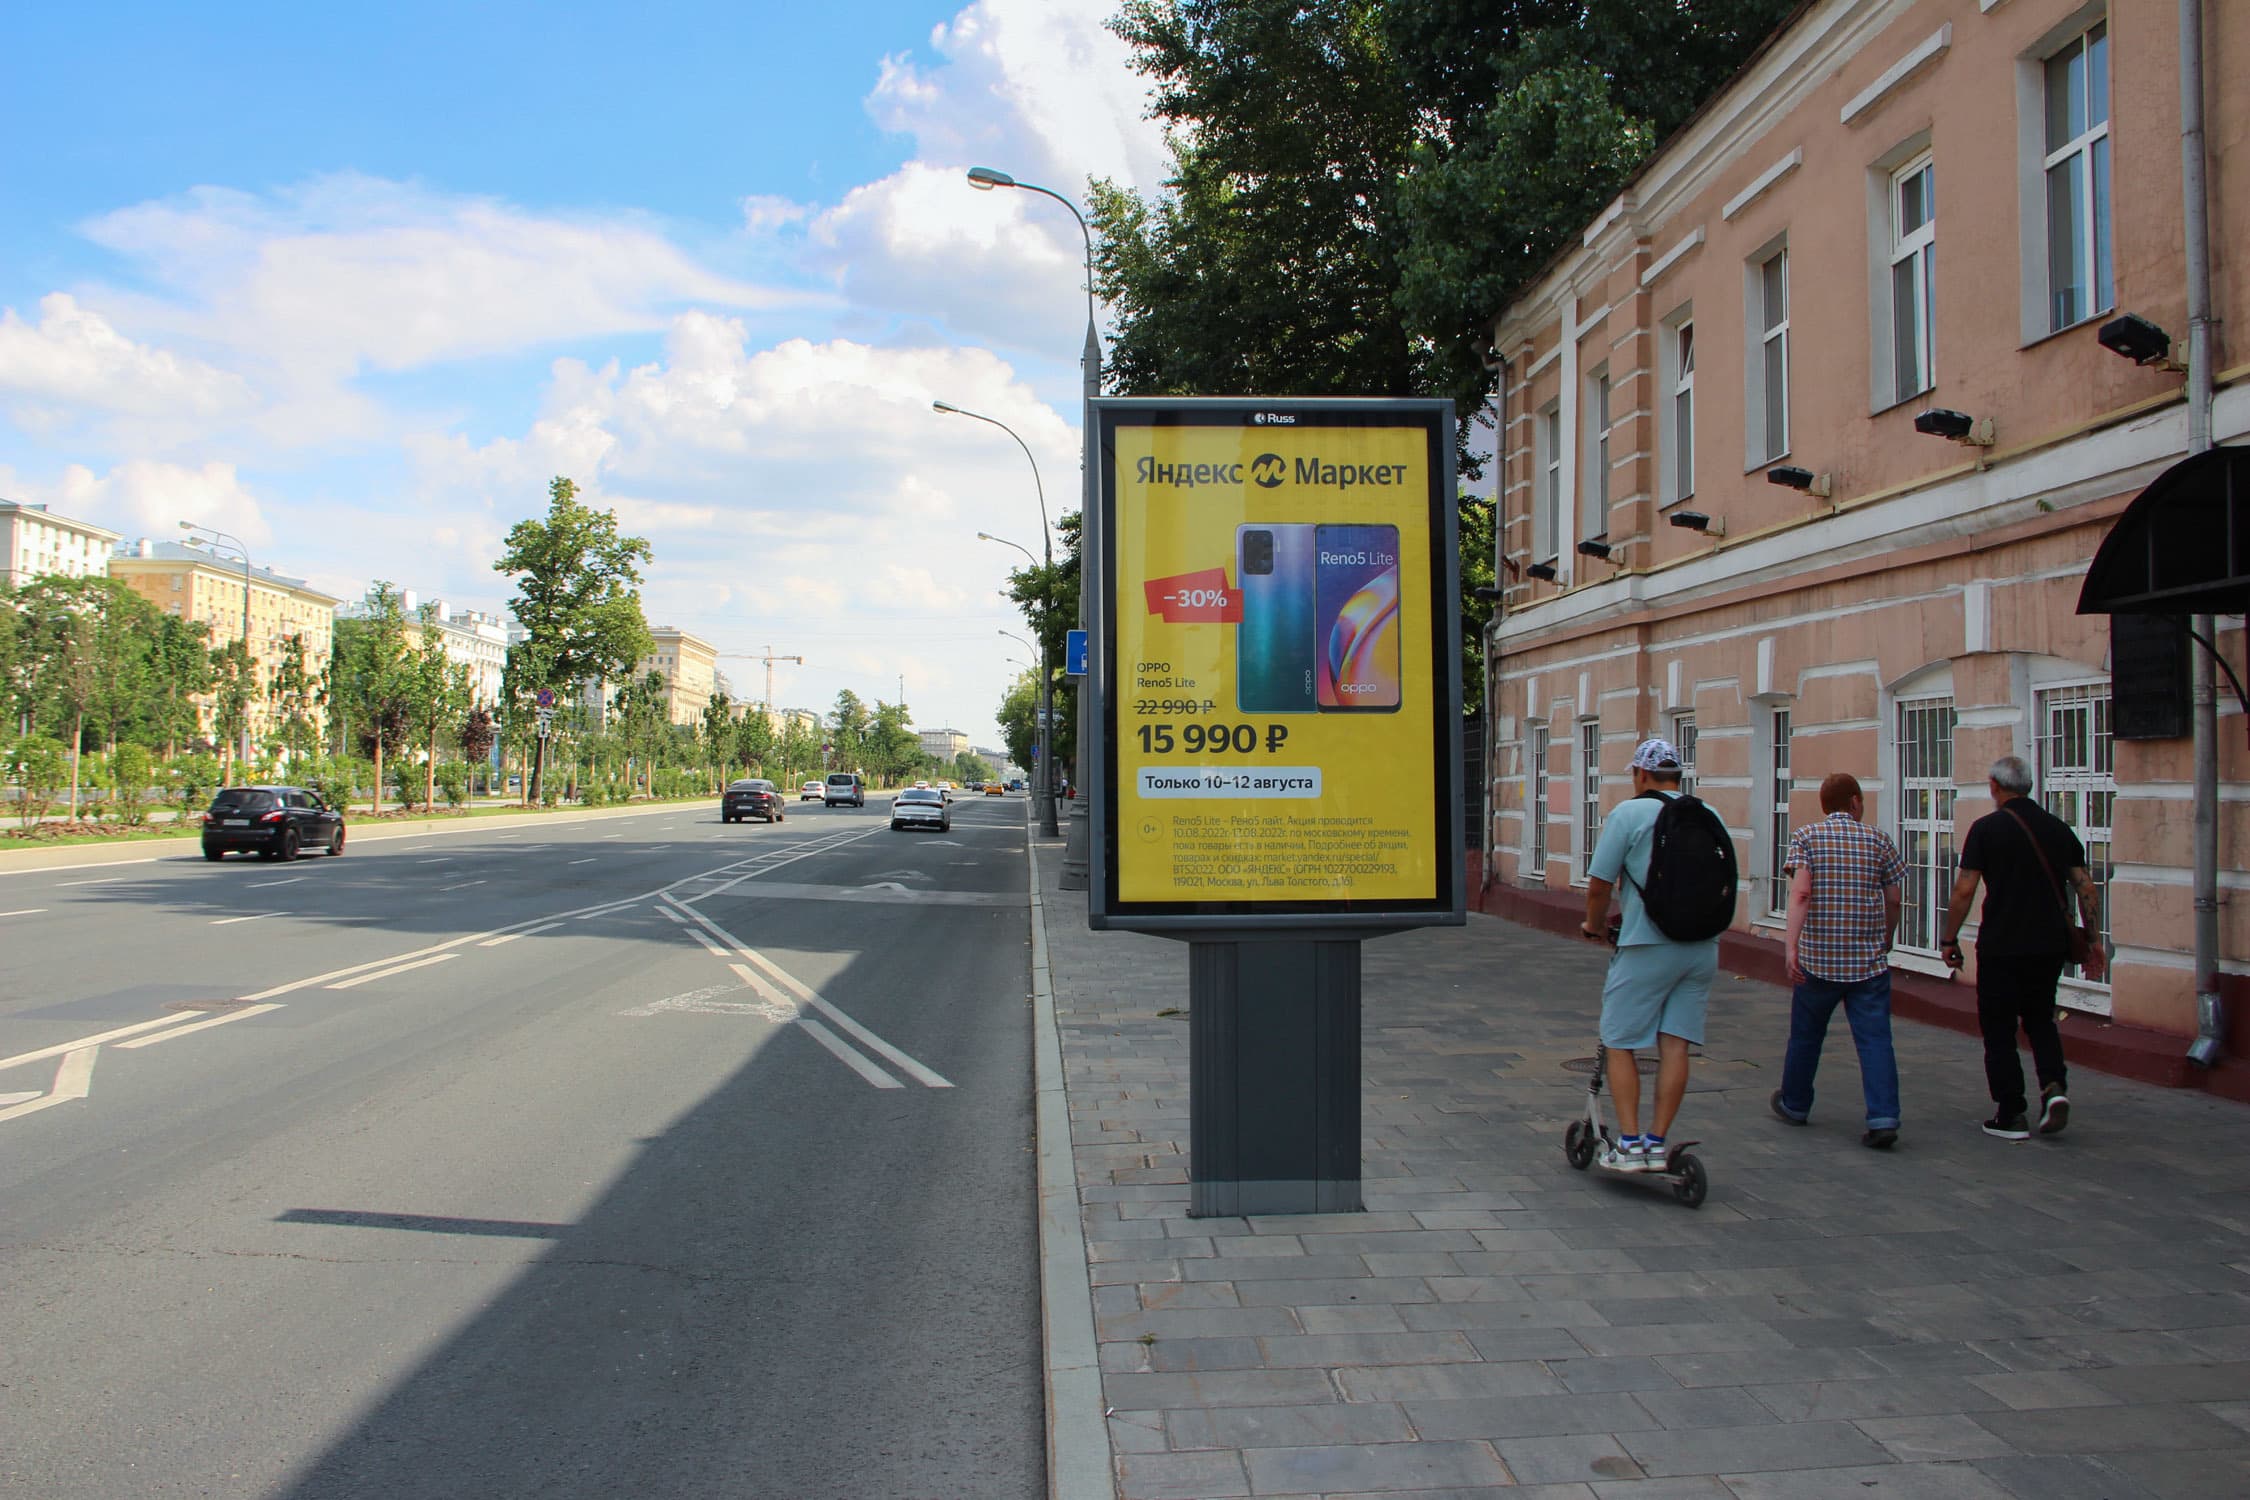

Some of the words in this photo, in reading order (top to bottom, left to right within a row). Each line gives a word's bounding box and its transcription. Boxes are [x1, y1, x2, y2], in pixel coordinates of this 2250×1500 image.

[1267, 413, 1296, 424] Russ
[1136, 456, 1244, 488] Яндекс
[1295, 457, 1407, 490] Маркет
[1320, 551, 1366, 565] Reno5
[1369, 551, 1394, 565] Lite
[1137, 662, 1171, 673] OPPO
[1137, 677, 1172, 688] Reno5
[1175, 677, 1196, 688] Lite
[1145, 775, 1201, 789] Только
[1253, 777, 1313, 791] августа
[1173, 815, 1202, 826] Reno5
[1203, 815, 1221, 826] Lite
[1143, 824, 1156, 833] 0+
[1308, 840, 1361, 851] Подробнее
[1363, 840, 1376, 850] об
